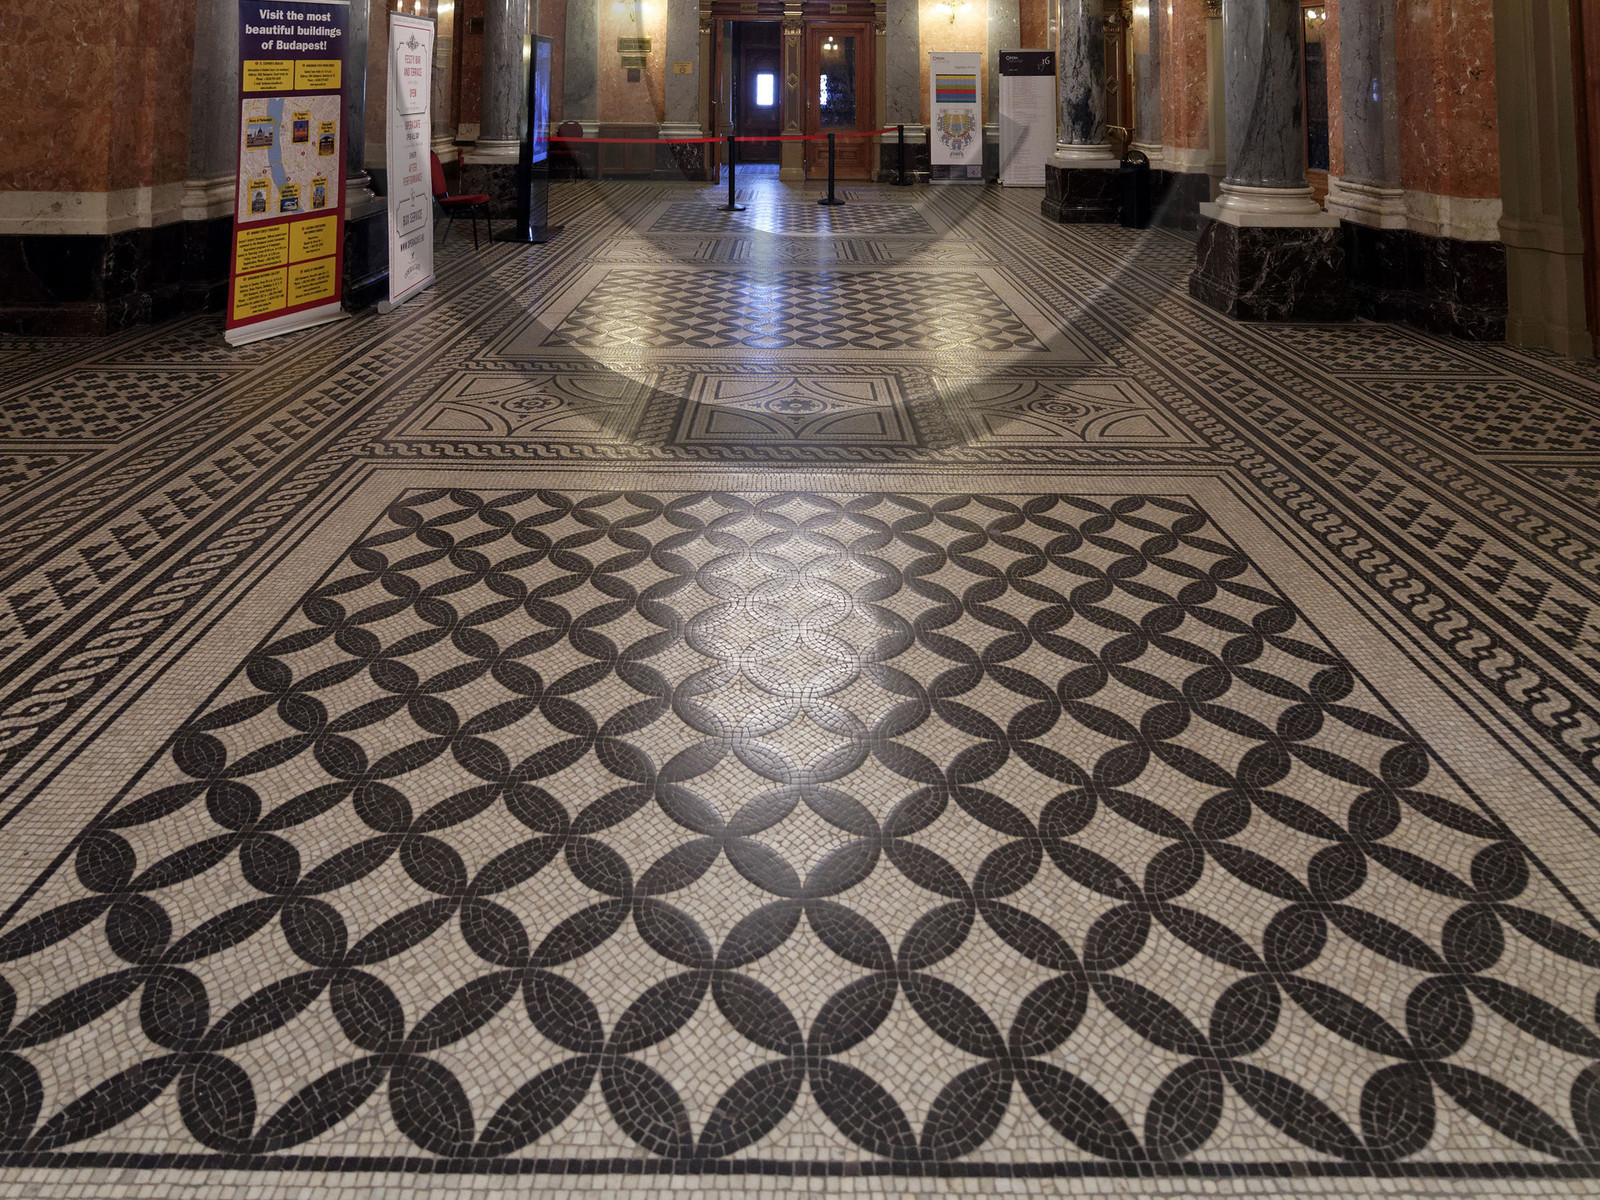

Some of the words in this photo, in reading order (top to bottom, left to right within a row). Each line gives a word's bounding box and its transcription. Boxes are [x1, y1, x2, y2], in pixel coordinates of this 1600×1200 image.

[259, 9, 284, 20] Visit
[286, 10, 304, 21] the
[306, 12, 331, 22] most
[245, 24, 294, 36] beautiful
[297, 26, 342, 38] buildings
[261, 39, 274, 50] of
[276, 40, 327, 52] Budapest!
